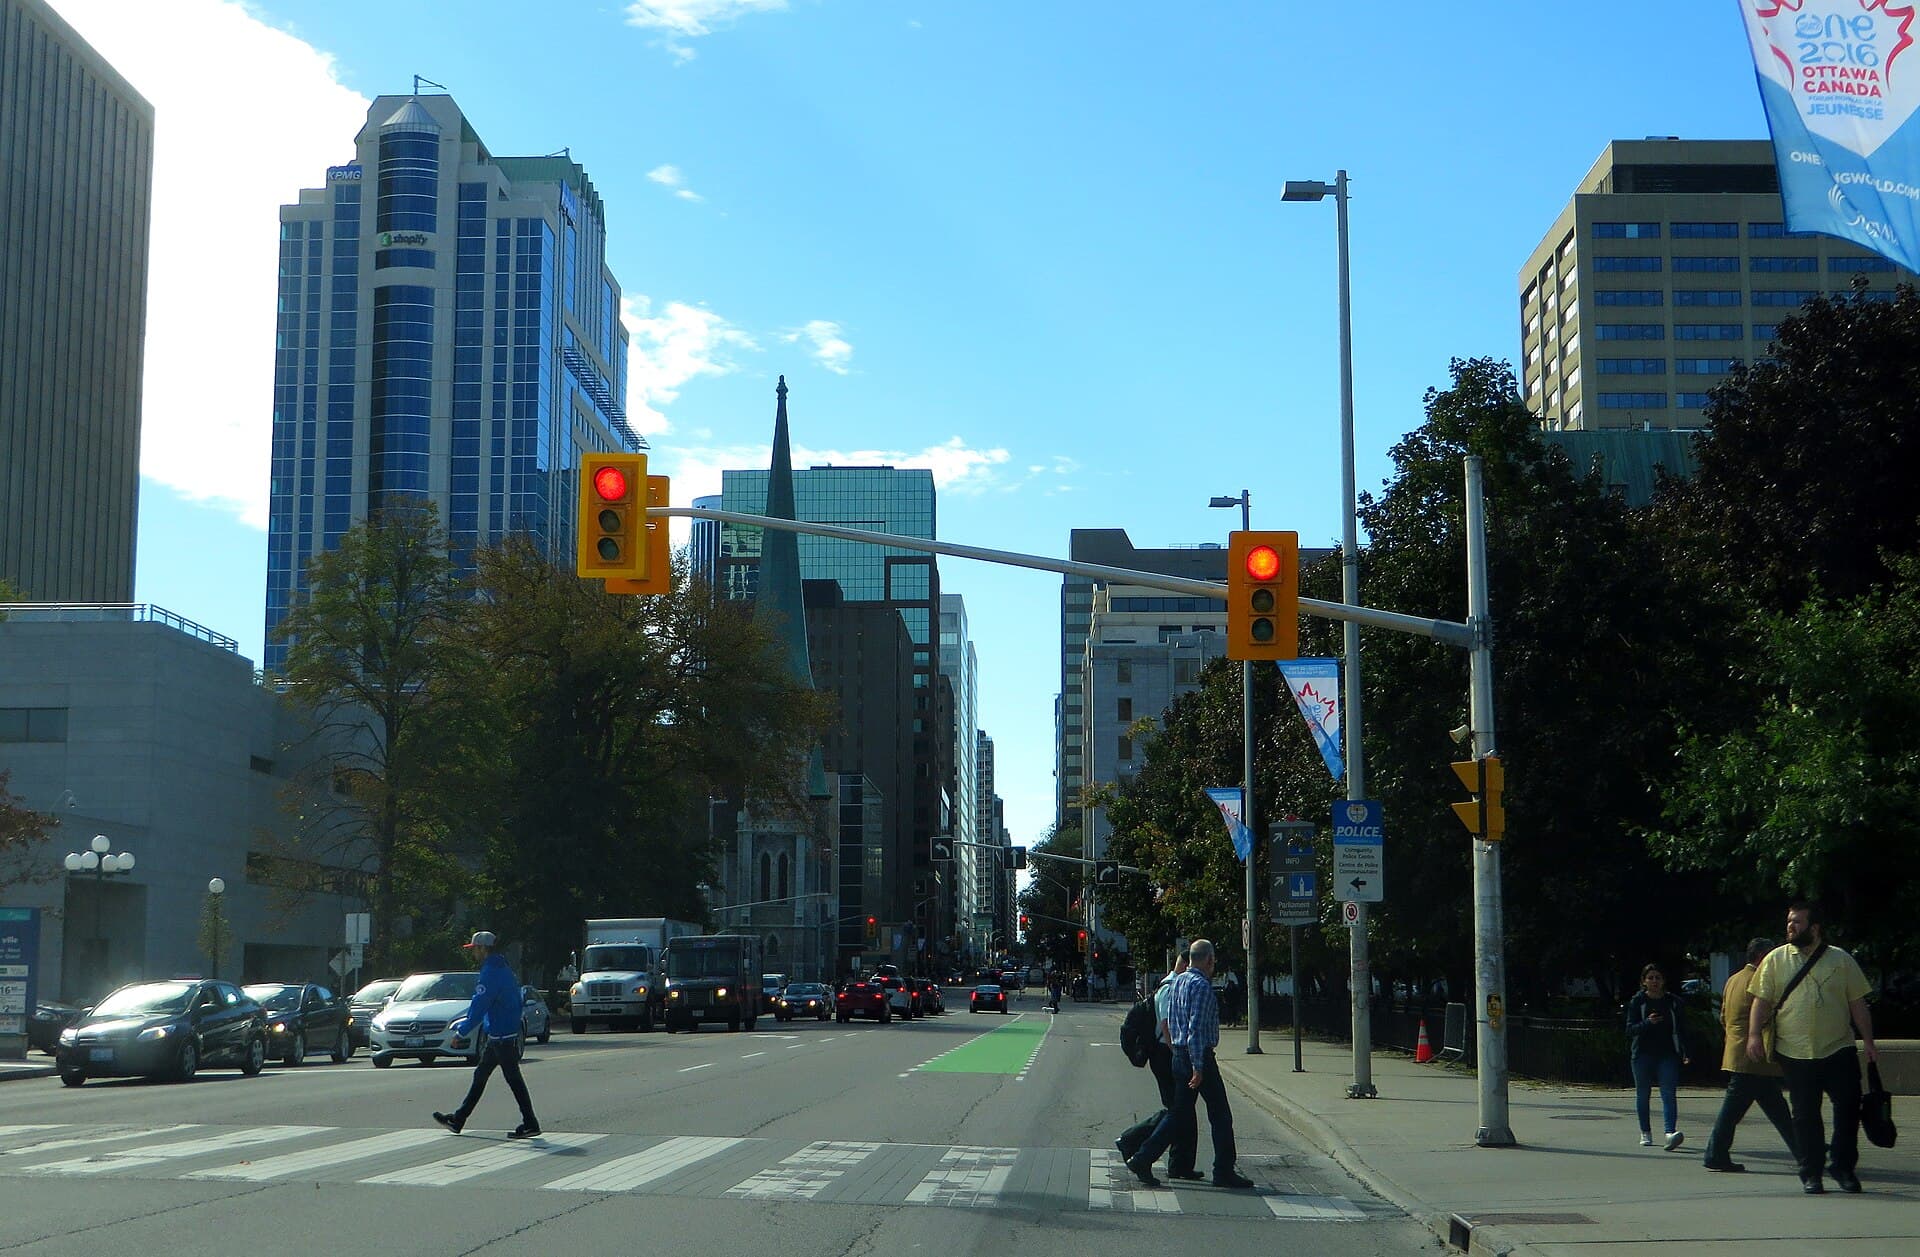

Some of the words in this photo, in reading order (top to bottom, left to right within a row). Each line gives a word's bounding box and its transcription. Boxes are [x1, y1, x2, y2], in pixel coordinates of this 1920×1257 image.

[1798, 42, 1880, 67] 2016
[1802, 65, 1880, 82] OTTAWA
[1803, 80, 1882, 98] CANADA
[1807, 103, 1884, 121] JEUNESSE
[327, 171, 361, 181] KPMG
[393, 233, 428, 246] shopify
[1336, 826, 1380, 838] POLICE
[1285, 857, 1300, 865] INFO
[1278, 901, 1311, 909] Parliament
[1279, 909, 1309, 917] Parlement
